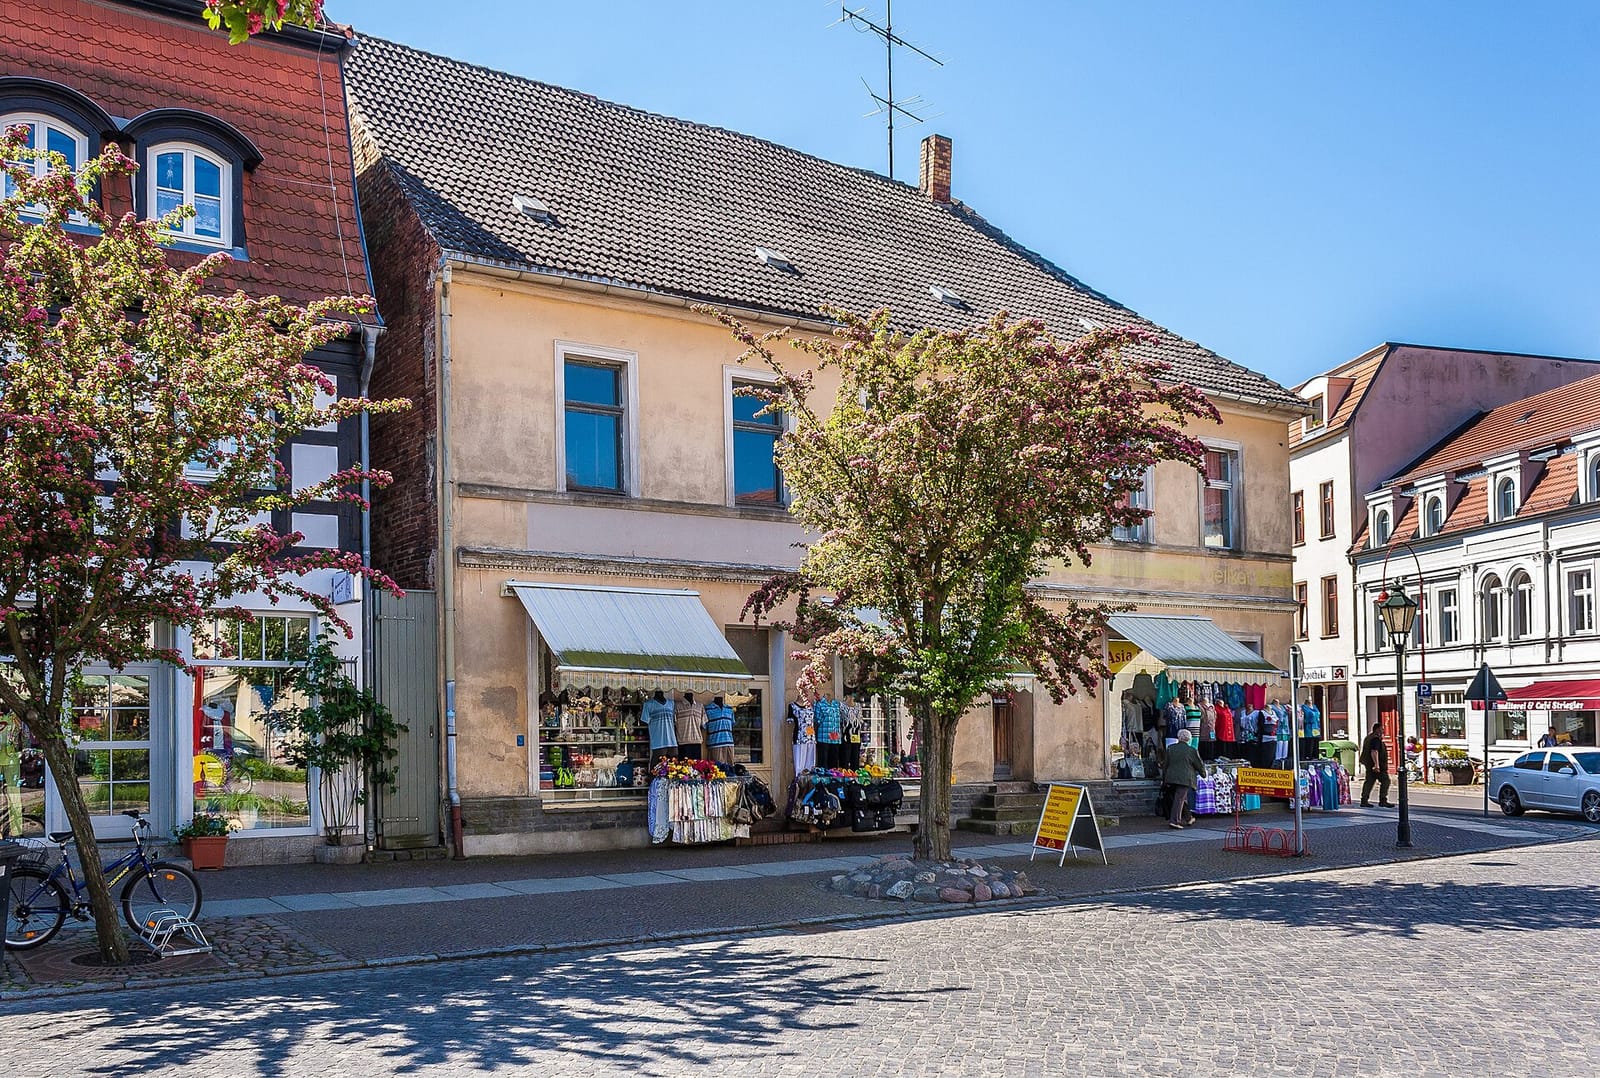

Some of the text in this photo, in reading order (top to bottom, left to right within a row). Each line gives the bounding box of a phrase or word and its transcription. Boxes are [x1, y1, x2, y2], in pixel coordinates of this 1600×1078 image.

[1108, 649, 1132, 663] Asia
[1420, 684, 1429, 695] P
[1242, 770, 1278, 779] TEXTILHANDEL
